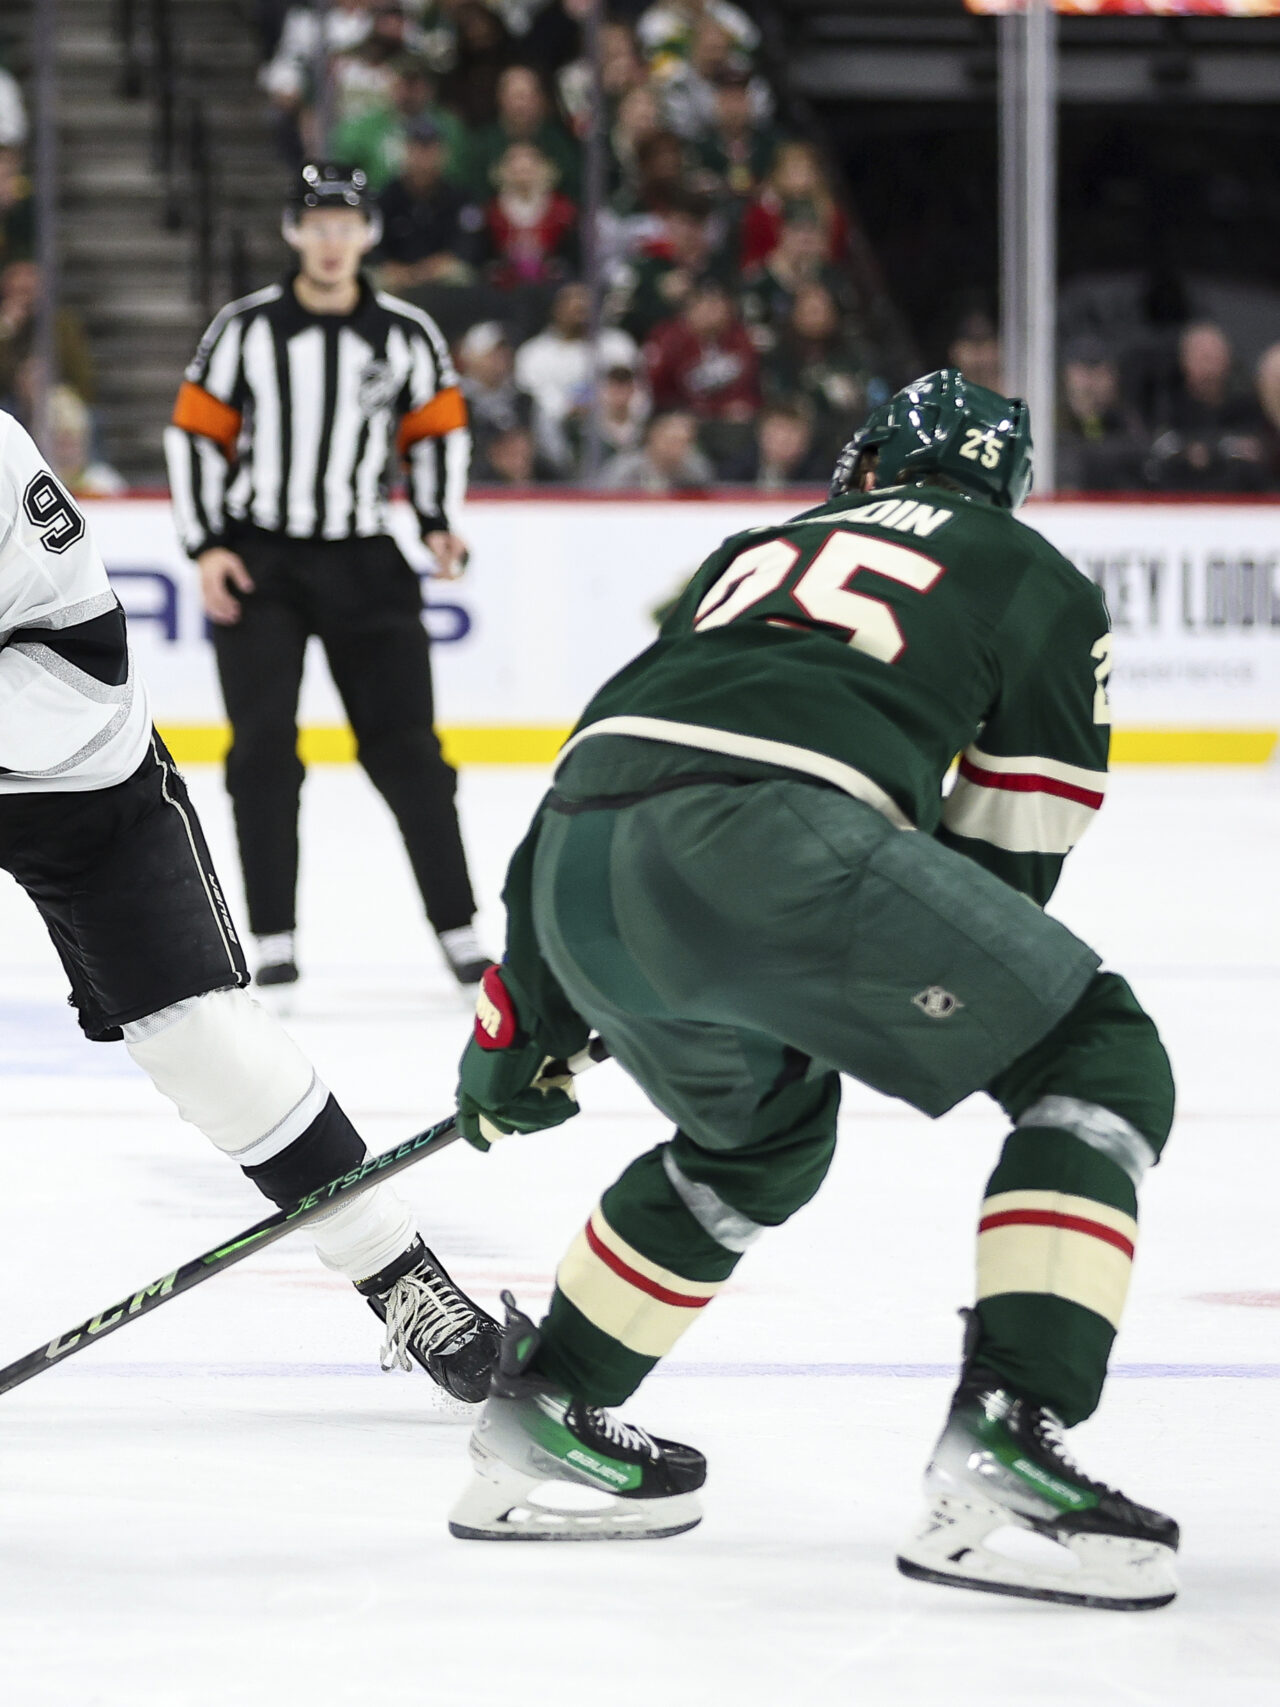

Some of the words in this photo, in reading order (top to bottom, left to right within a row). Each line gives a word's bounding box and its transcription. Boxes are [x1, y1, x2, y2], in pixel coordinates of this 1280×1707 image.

[959, 428, 1004, 470] 25
[208, 873, 238, 945] BAUER
[286, 1128, 436, 1220] JETSPEED
[45, 1269, 178, 1359] CCM
